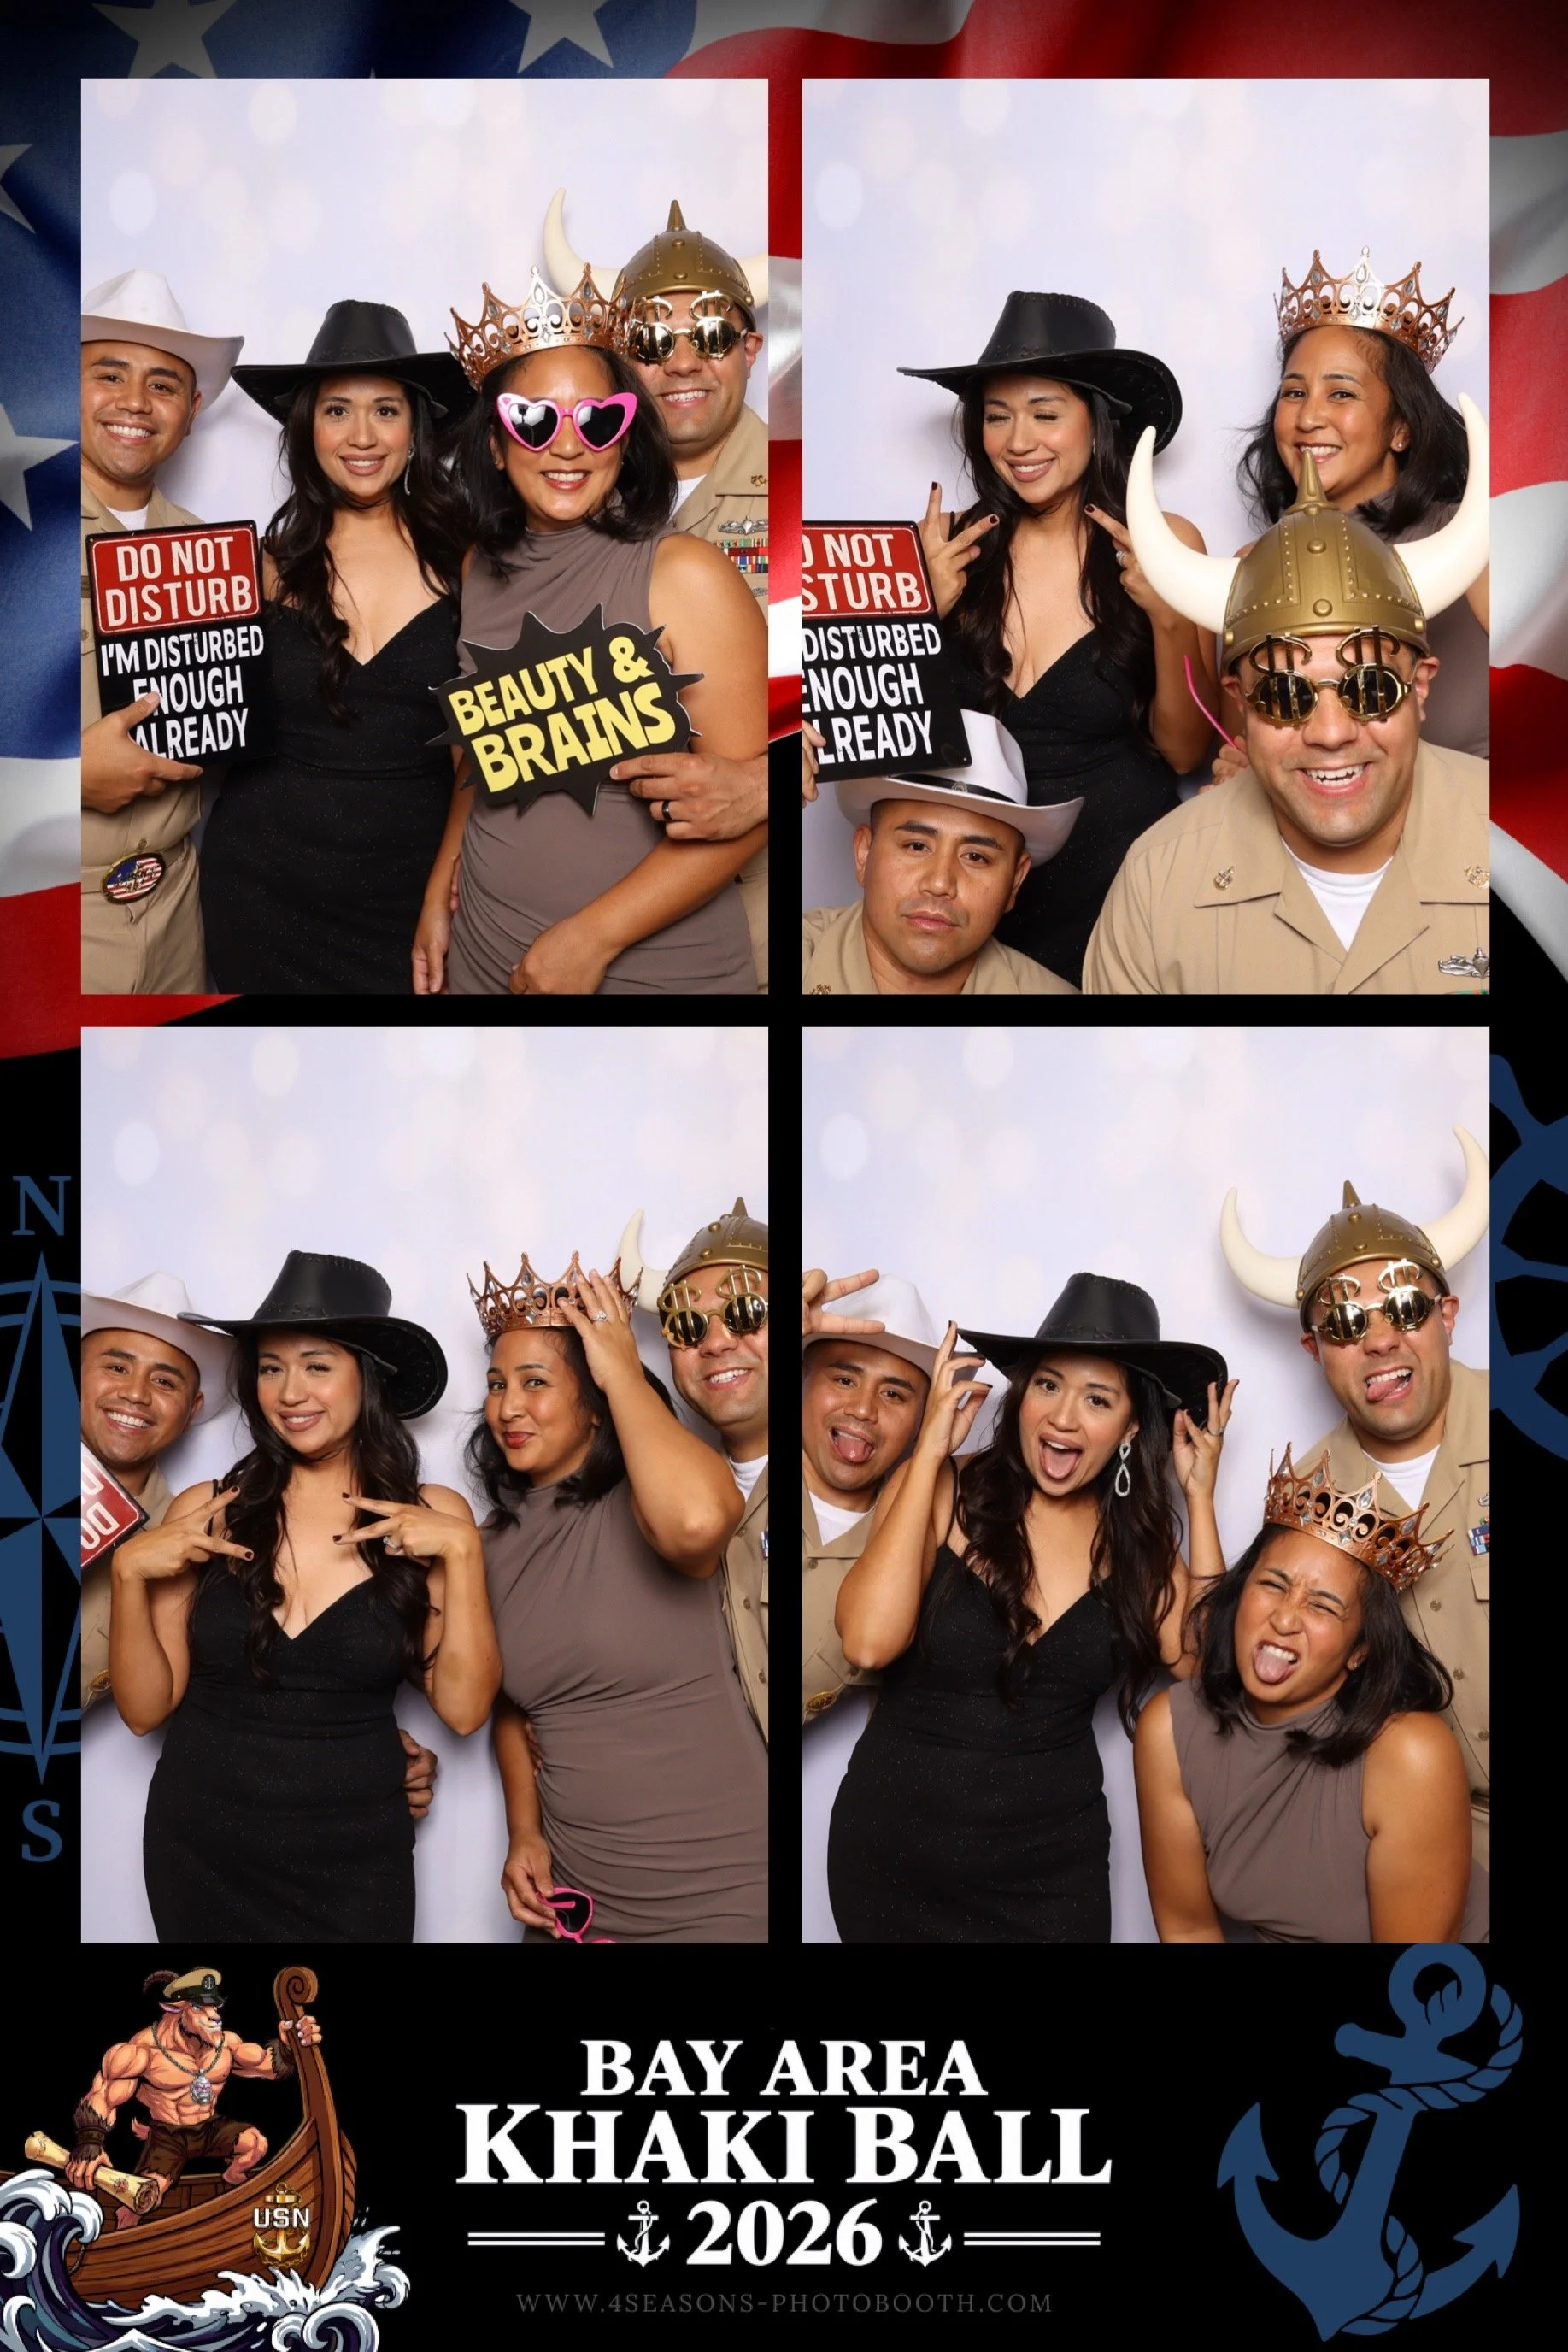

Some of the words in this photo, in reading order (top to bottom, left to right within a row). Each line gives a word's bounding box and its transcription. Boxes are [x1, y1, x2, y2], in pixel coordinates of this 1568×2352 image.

[116, 544, 161, 582] DO
[170, 536, 234, 576] NOT
[823, 533, 894, 567] NOT
[105, 574, 253, 628] DISTURB
[101, 641, 140, 676] I'M
[146, 625, 265, 671] DISTURBED
[802, 623, 941, 662] DISTURBED
[132, 665, 244, 716] ENOUGH
[448, 646, 598, 736] BEAUTY
[608, 636, 655, 683] &
[134, 708, 249, 760] ALREADY
[471, 682, 676, 793] BRAINS
[812, 710, 932, 765] LREADY
